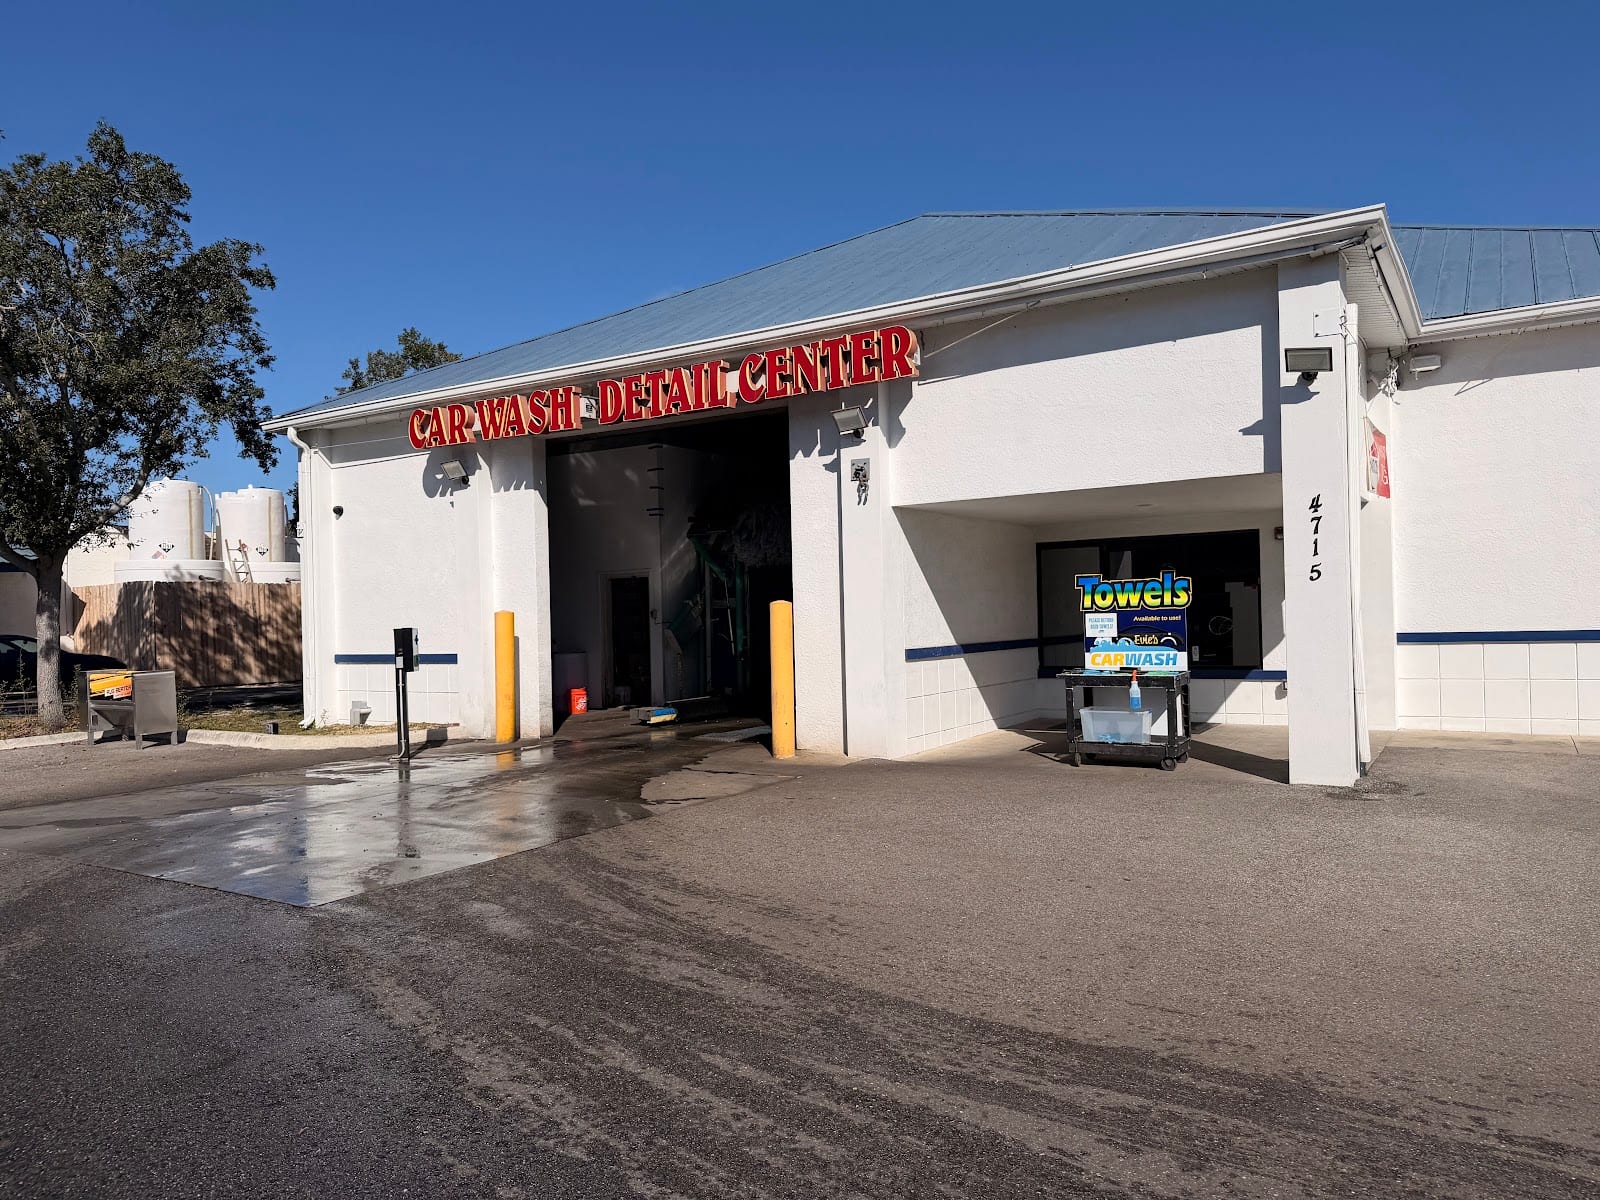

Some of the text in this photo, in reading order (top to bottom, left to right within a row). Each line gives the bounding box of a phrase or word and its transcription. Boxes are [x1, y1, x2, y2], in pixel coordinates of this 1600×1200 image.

[408, 325, 920, 449] CAR WASH DETAIL CENTER
[1308, 493, 1322, 581] 4715
[1076, 571, 1191, 610] Towels
[1134, 634, 1159, 645] Evie's
